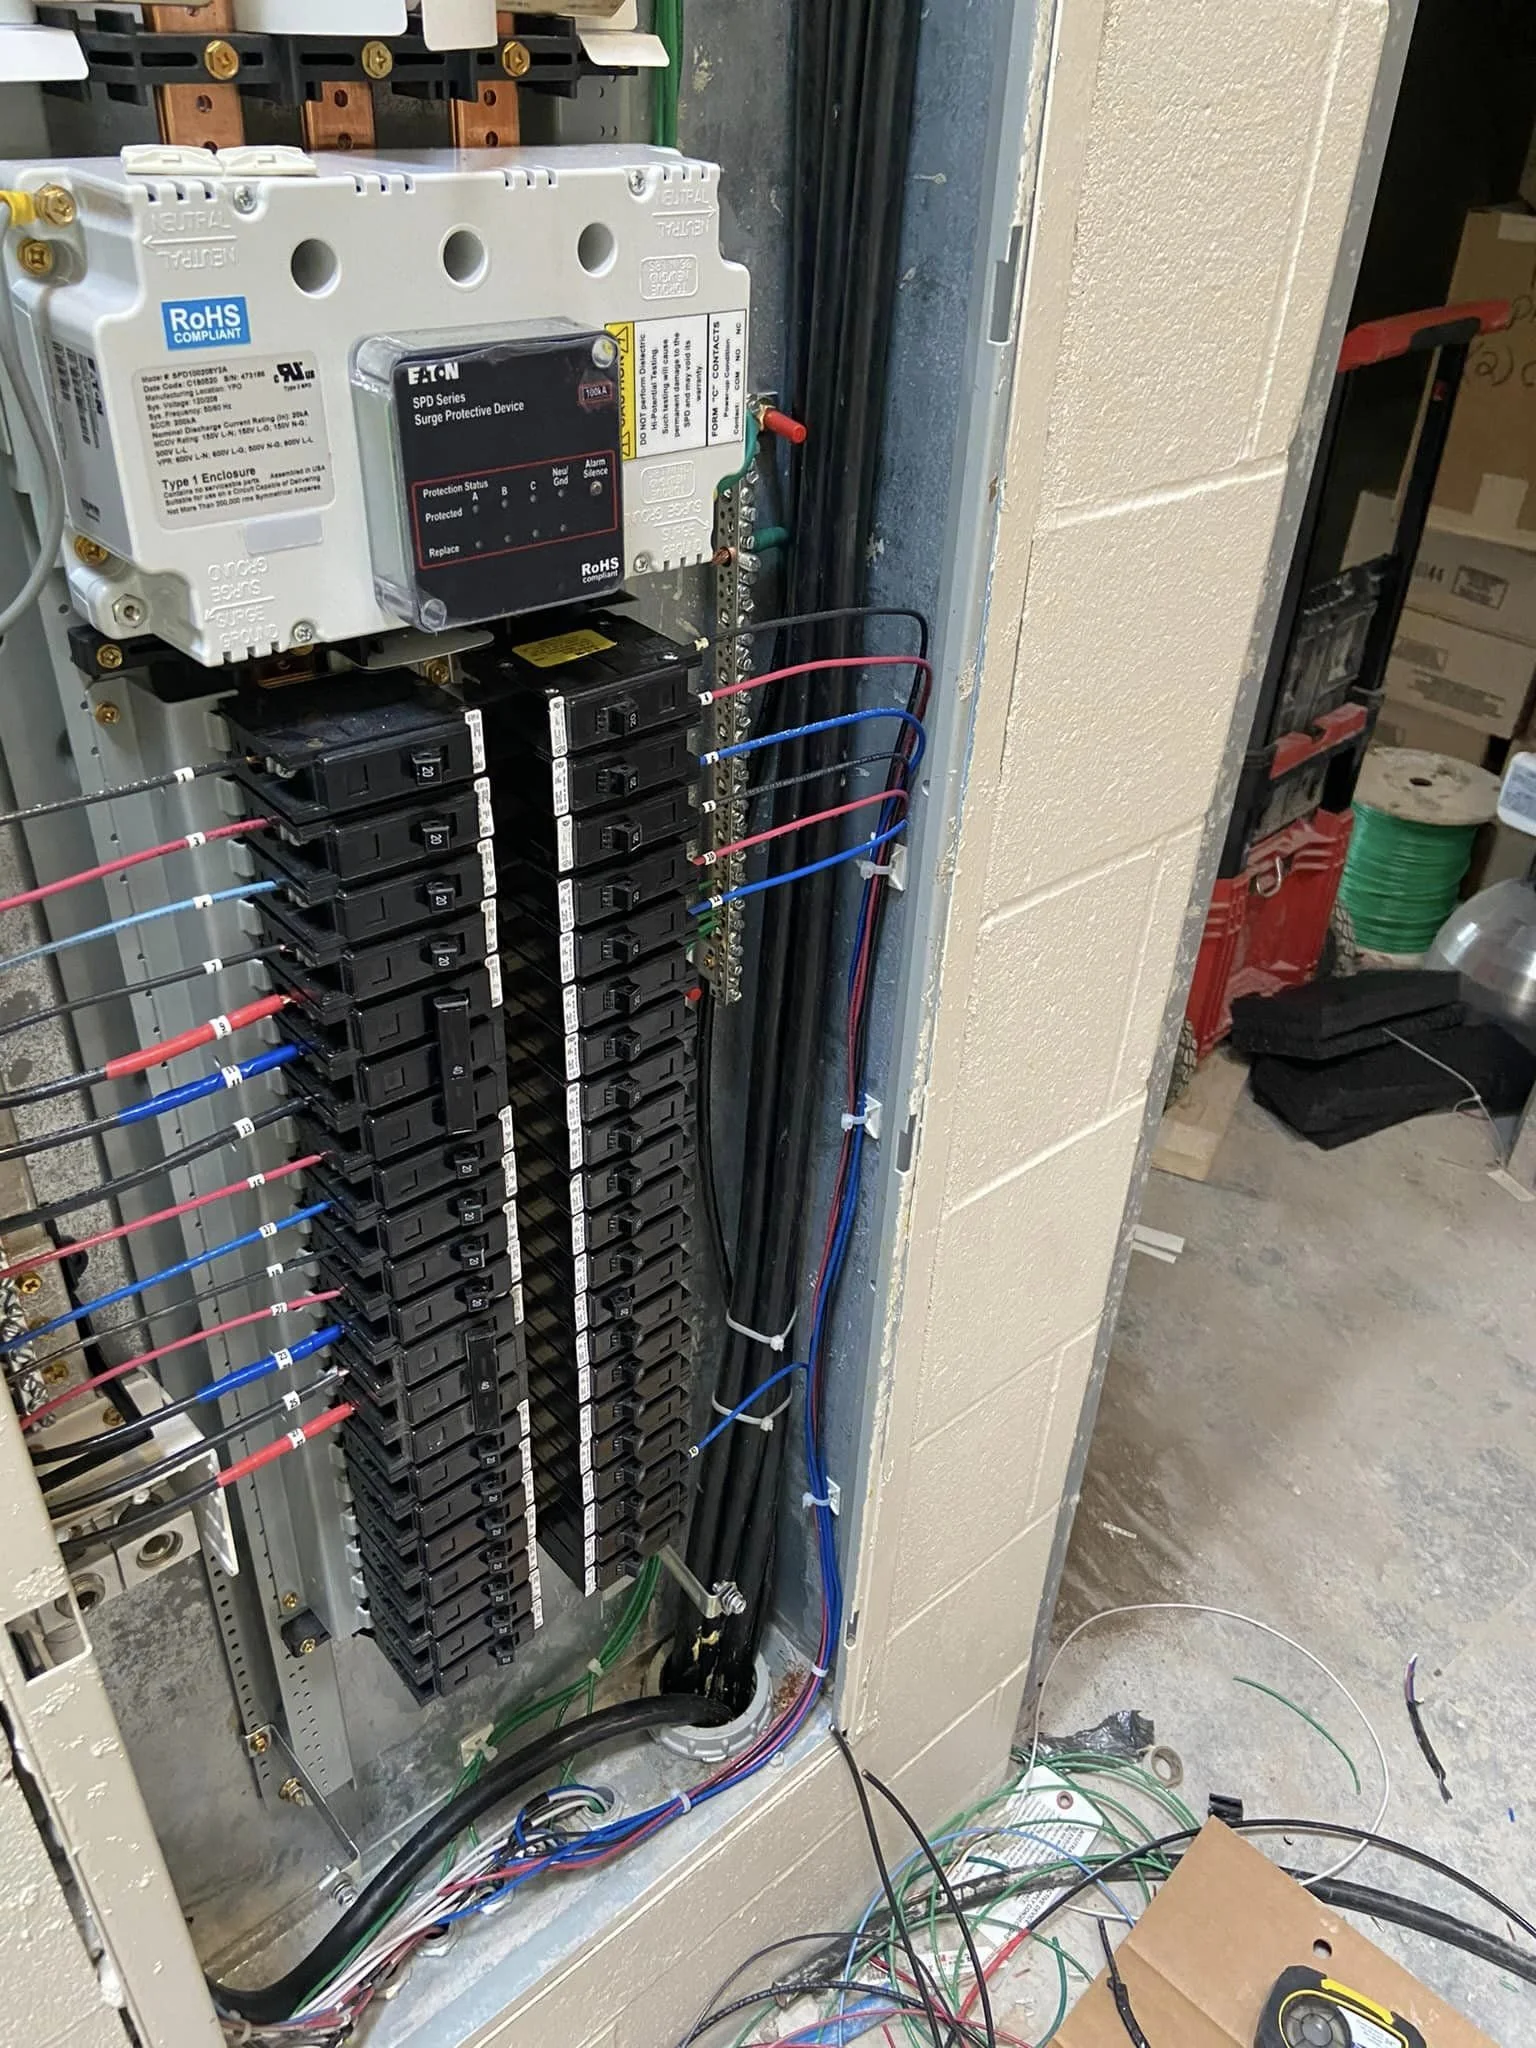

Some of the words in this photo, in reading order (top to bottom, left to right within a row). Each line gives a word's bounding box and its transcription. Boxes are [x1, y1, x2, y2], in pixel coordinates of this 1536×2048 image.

[169, 303, 241, 332] RoHS
[735, 321, 742, 335] NC
[174, 327, 242, 344] COMPLIANT
[673, 348, 680, 358] to
[712, 321, 720, 380] CONTACTS
[735, 348, 741, 362] NO
[673, 359, 681, 393] damage
[684, 373, 692, 391] may
[639, 377, 647, 410] perform
[662, 383, 670, 412] testing
[412, 397, 435, 410] SPD
[436, 392, 467, 406] Series
[414, 413, 444, 427] Surge
[445, 403, 493, 422] Protective
[494, 400, 526, 415] Device
[639, 412, 647, 431] NOT
[662, 413, 670, 435] Such
[639, 432, 647, 446] DO
[585, 457, 607, 470] Alarm
[161, 478, 189, 492] Type
[192, 475, 198, 485] 1
[202, 467, 256, 484] Enclosure
[583, 467, 609, 479] Silence
[553, 475, 569, 487] Gnd
[423, 483, 463, 499] Protection
[464, 479, 489, 493] Status
[471, 492, 480, 501] A
[501, 486, 508, 496] B
[530, 480, 537, 491] C
[425, 507, 463, 523] Protected
[429, 544, 460, 558] Replace
[581, 556, 620, 577] RoHS
[582, 570, 619, 584] compliant
[629, 712, 637, 727] 20
[421, 765, 434, 778] 20
[430, 833, 442, 845] 20
[435, 895, 448, 907] 20
[438, 956, 450, 967] 20
[242, 1123, 252, 1134] 13
[461, 1164, 473, 1174] 20
[464, 1212, 475, 1222] 20
[278, 1352, 288, 1361] 23
